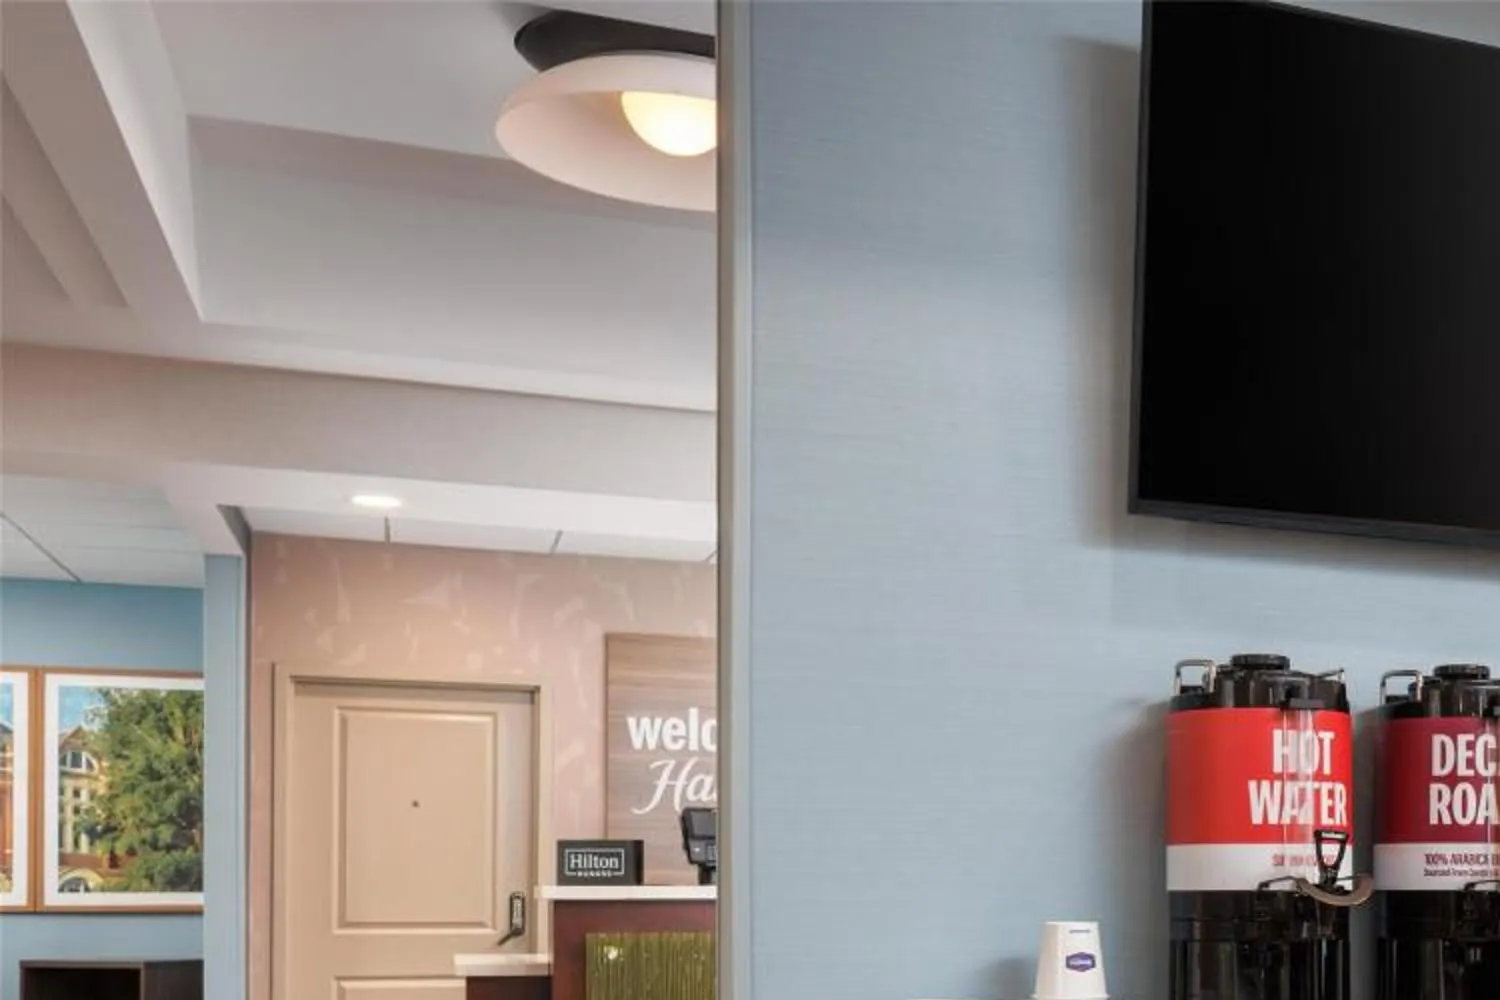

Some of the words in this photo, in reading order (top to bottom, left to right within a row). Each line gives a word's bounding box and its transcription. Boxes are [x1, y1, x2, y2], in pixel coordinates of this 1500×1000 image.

[1273, 729, 1335, 775] HOT
[1247, 779, 1347, 827] WATER
[569, 853, 619, 869] Hilton
